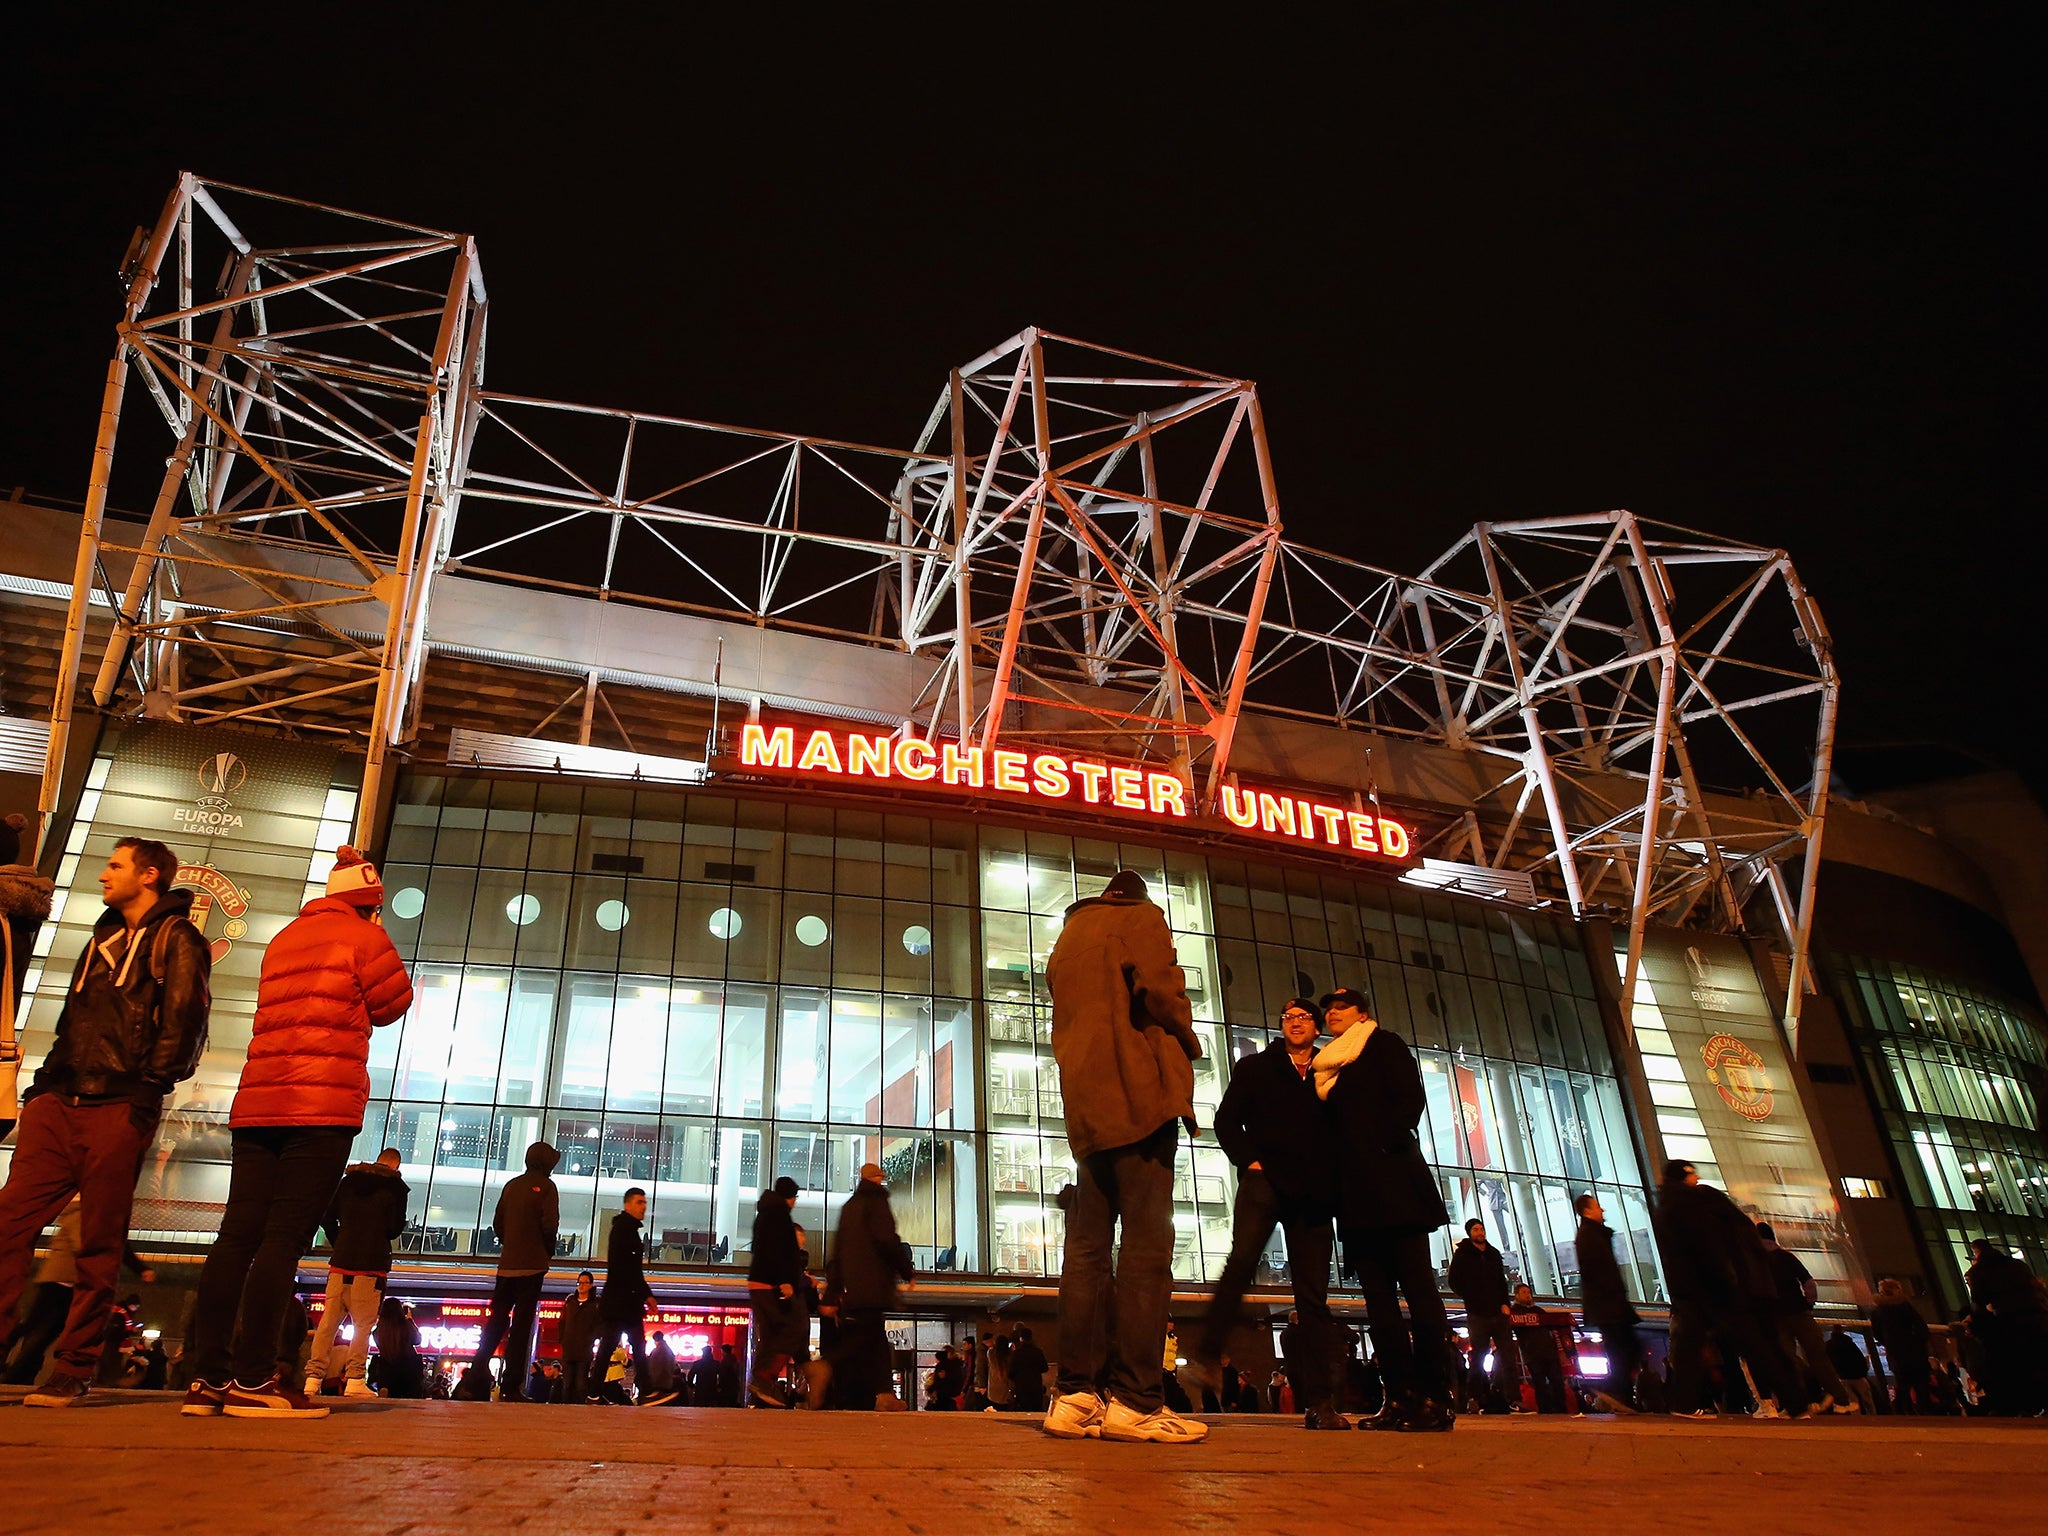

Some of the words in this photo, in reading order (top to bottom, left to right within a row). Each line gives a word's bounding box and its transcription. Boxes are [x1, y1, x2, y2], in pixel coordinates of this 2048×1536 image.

[741, 723, 1188, 818] MANCHESTER
[1221, 785, 1411, 858] UNITED
[196, 798, 229, 811] UEFA
[173, 808, 244, 828] EUROPA
[183, 823, 230, 836] LEAGUE
[175, 869, 240, 911] CHESTER
[1691, 990, 1730, 1005] EUROPA
[1705, 1037, 1761, 1070] MANCHESTER
[1731, 1099, 1769, 1116] UNITED
[441, 1305, 481, 1317] Welcome
[663, 1313, 682, 1323] Sale
[685, 1314, 704, 1324] Now
[707, 1314, 721, 1324] On
[1511, 1313, 1537, 1323] UNITED
